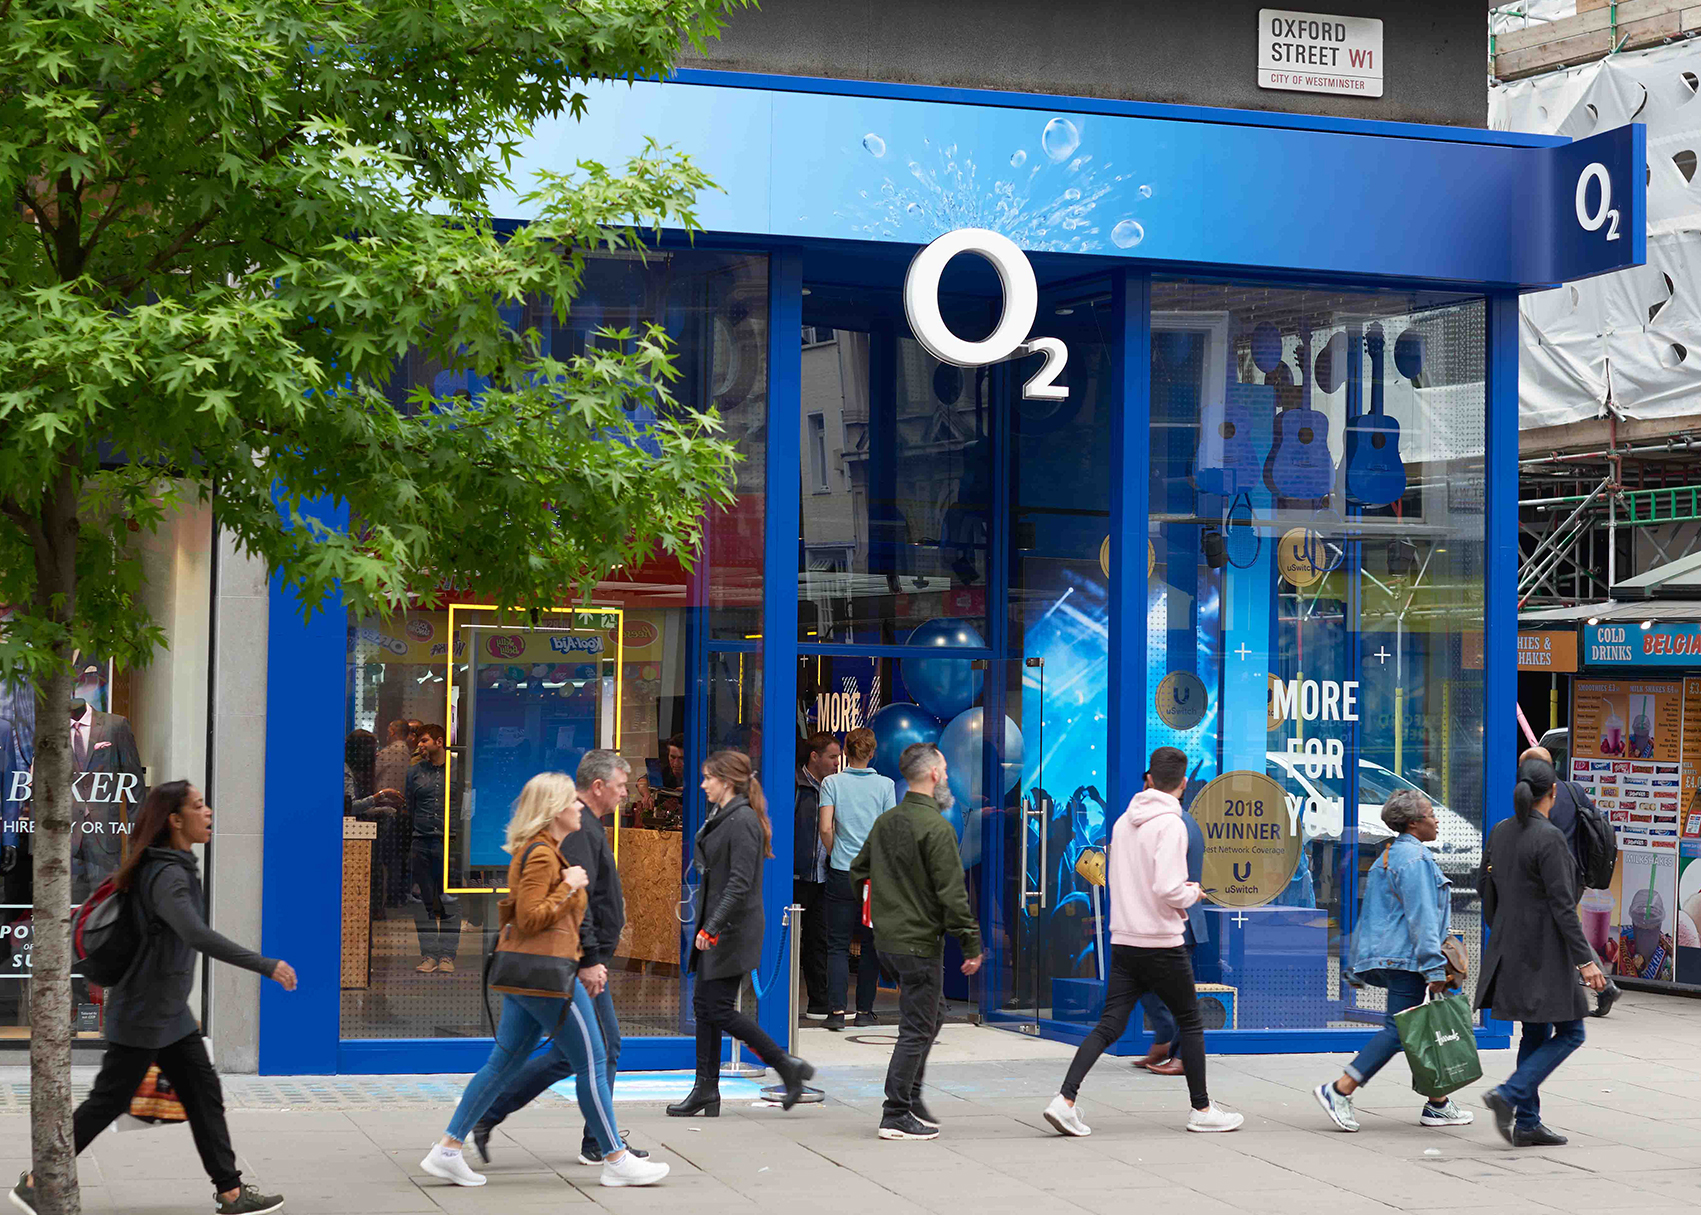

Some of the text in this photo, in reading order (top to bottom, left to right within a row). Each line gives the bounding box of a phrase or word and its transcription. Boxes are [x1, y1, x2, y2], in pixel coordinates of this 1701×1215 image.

[1271, 18, 1345, 42] OXFORD
[1271, 42, 1373, 69] STREET W1
[1270, 73, 1365, 89] CITY OF WESTMINSTER
[1287, 564, 1314, 572] uSwitc
[1597, 628, 1625, 643] COLD
[1643, 634, 1701, 655] BELGIA
[1518, 652, 1552, 665] HAKES
[1592, 645, 1632, 661] DRINKS
[1273, 680, 1359, 721] MORE
[817, 692, 861, 732] MORE
[1166, 707, 1197, 716] uSwitch
[1287, 738, 1344, 779] FOR
[6, 770, 138, 804] BKER
[1224, 800, 1264, 817] 2018
[1284, 796, 1344, 837] YOU
[81, 821, 104, 834] OR
[1206, 822, 1281, 840] WINNER
[1204, 845, 1285, 856] est Network Coverage
[1625, 854, 1673, 867] MILKSHAKES
[1225, 885, 1259, 894] uSwitch
